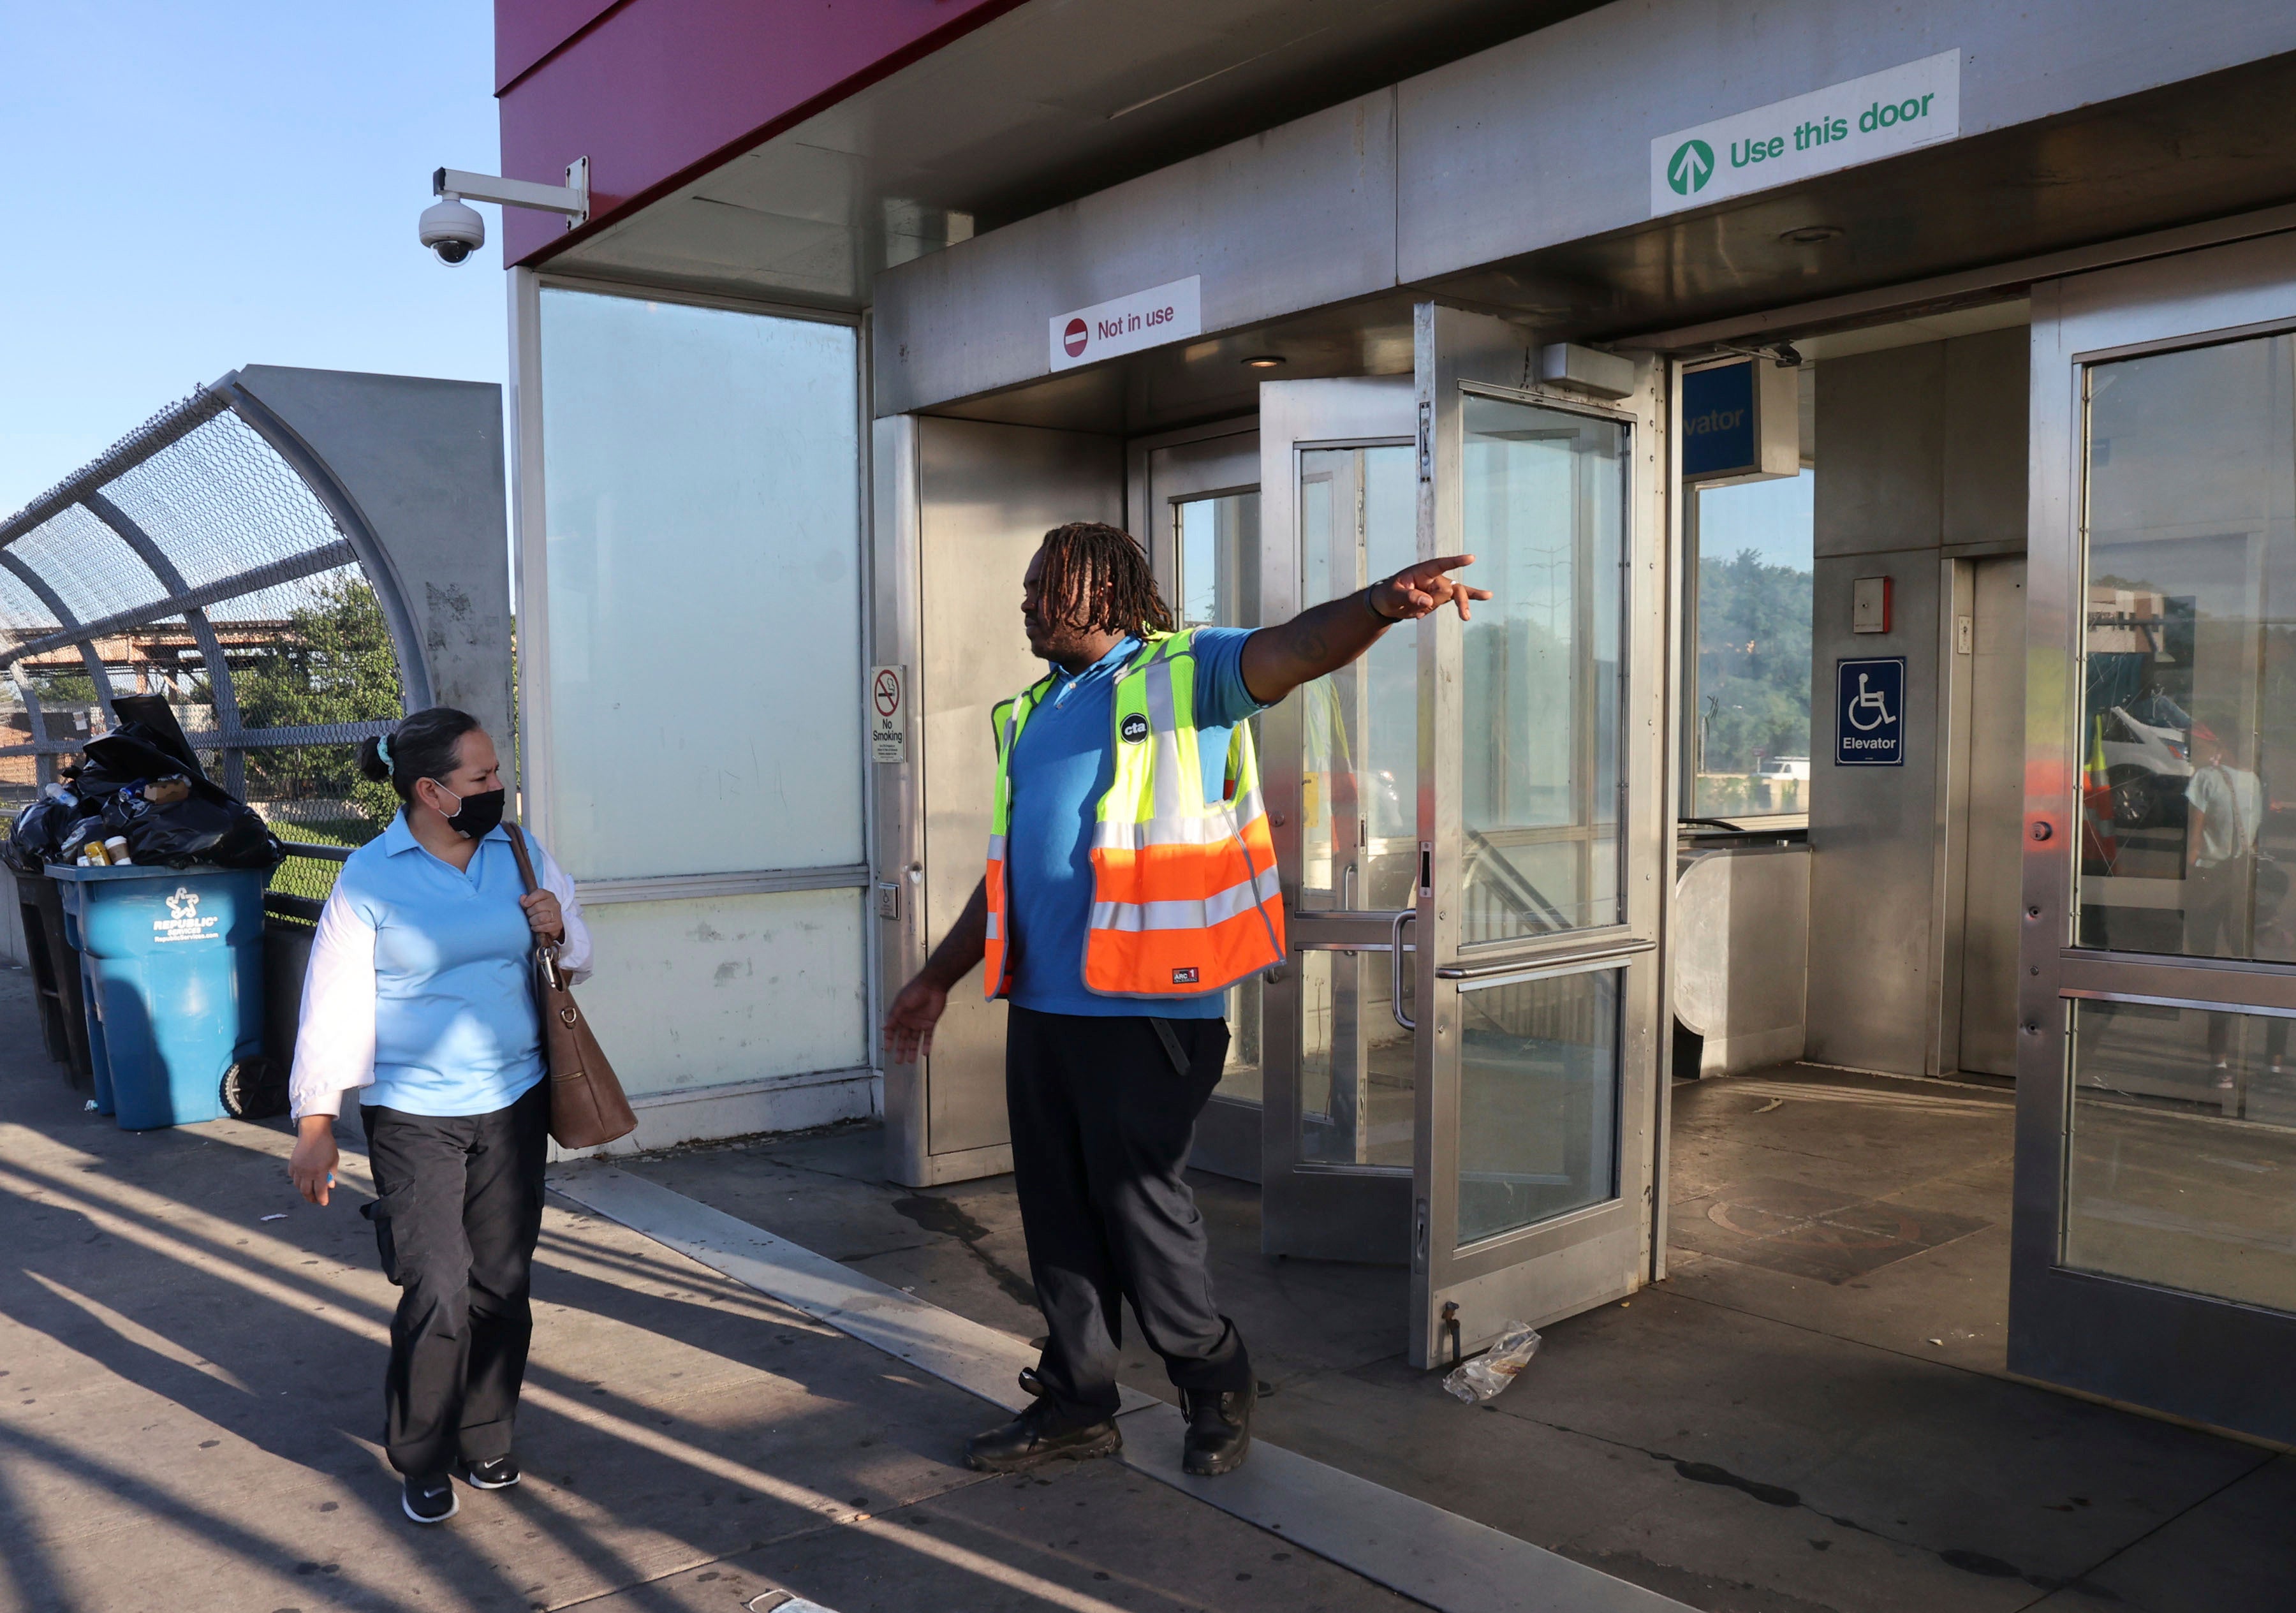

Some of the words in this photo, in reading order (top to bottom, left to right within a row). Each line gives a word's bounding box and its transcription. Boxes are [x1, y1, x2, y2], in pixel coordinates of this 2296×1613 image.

[1730, 138, 1785, 168] Use
[1793, 115, 1848, 151] this
[1858, 92, 1934, 133] door
[1098, 317, 1123, 340] Not
[1128, 313, 1140, 332] in
[1146, 306, 1174, 327] use
[1683, 408, 1744, 436] vator
[882, 718, 892, 730] No
[1124, 723, 1146, 735] cta
[872, 730, 902, 744] Smoking
[1843, 737, 1896, 749] Elevator
